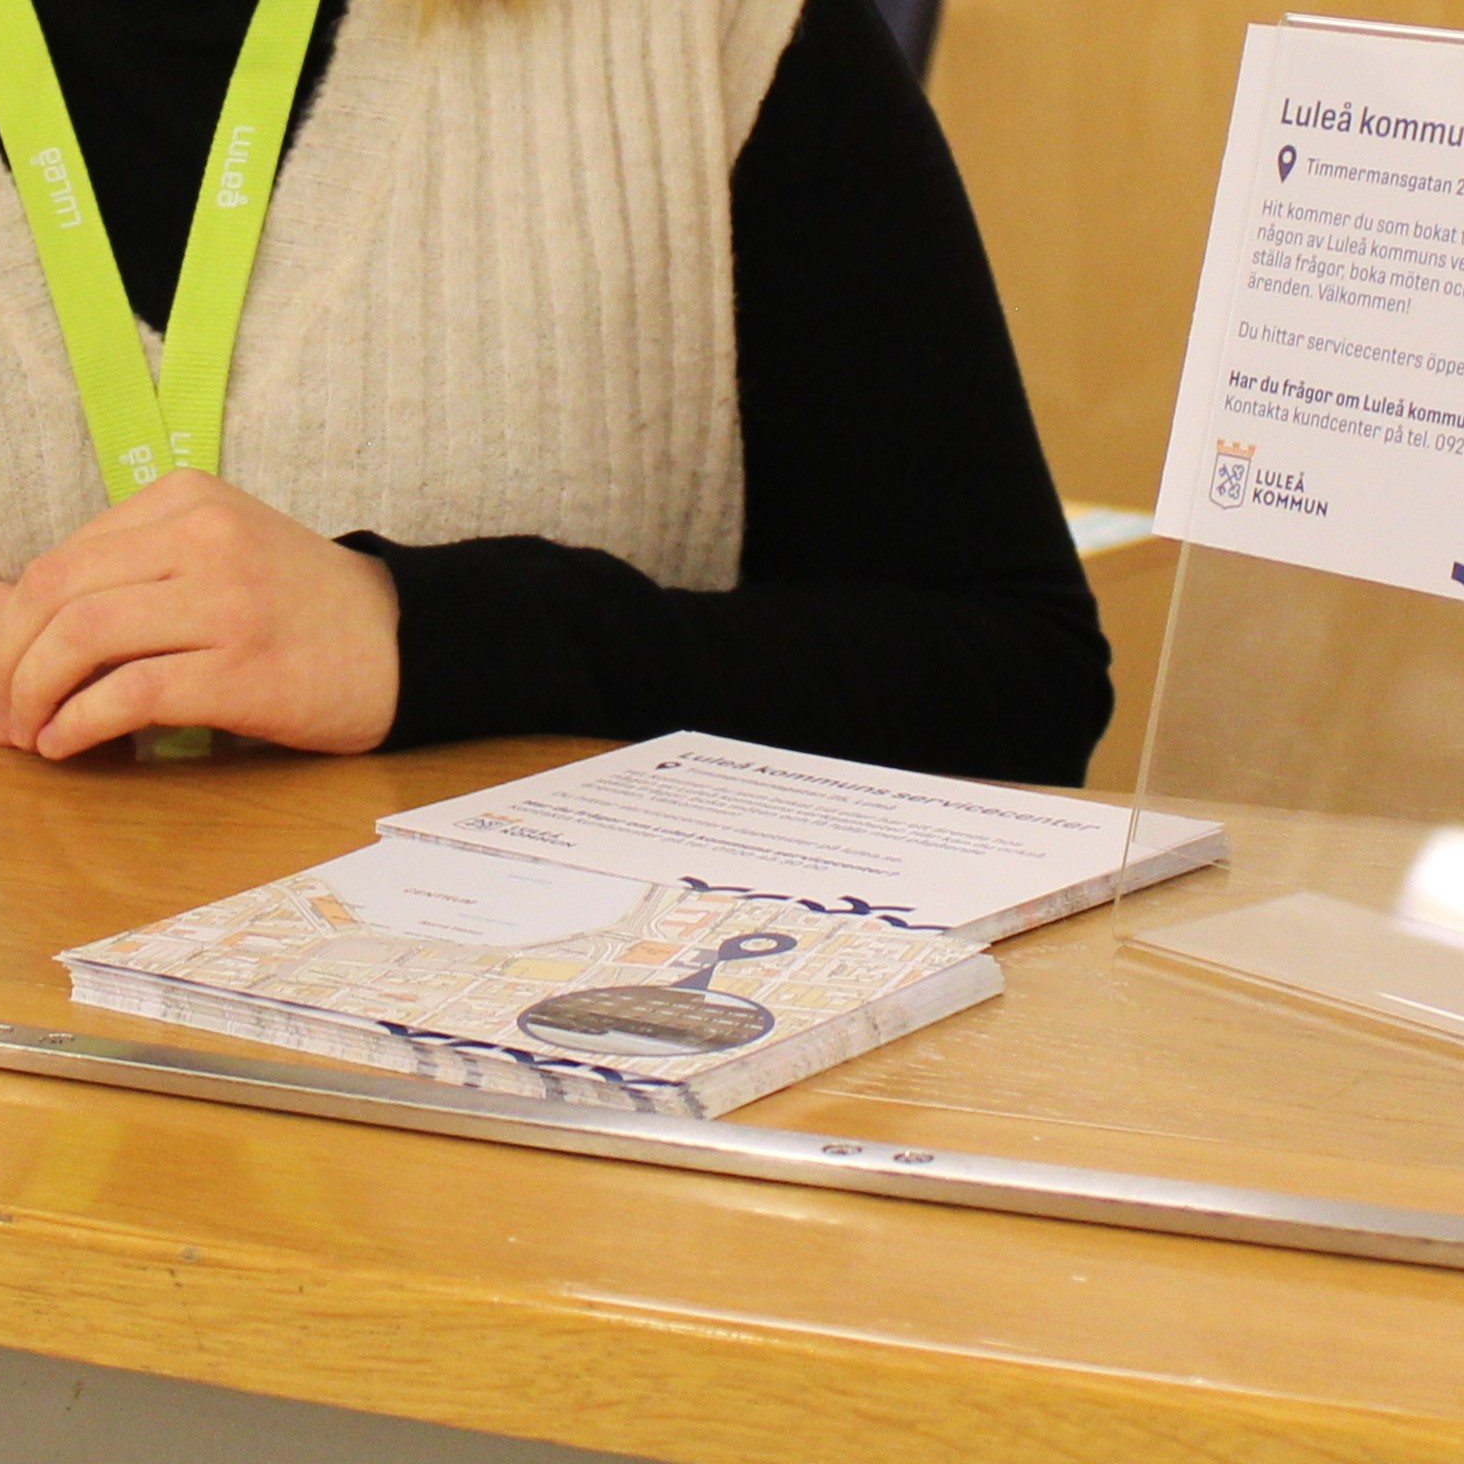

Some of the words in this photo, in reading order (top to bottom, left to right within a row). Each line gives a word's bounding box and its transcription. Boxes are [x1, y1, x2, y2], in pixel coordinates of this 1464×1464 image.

[1281, 98, 1352, 132] Luleå
[1307, 157, 1452, 194] Timmermansgatan
[1262, 199, 1284, 218] Hit
[1286, 202, 1351, 227] kommer
[1354, 213, 1374, 231] du
[1376, 219, 1410, 236] som
[1413, 221, 1457, 244] bokat
[1257, 223, 1303, 246] någon
[1306, 234, 1325, 249] av
[1327, 234, 1367, 256] Luleå
[1370, 239, 1447, 268] kommuns
[1252, 249, 1292, 269] ställa
[1295, 253, 1345, 280] frågor,
[1349, 262, 1386, 284] boka
[1389, 270, 1440, 292] möten
[1247, 275, 1312, 298] ärenden.
[1318, 283, 1411, 313] Välkommen!
[1238, 321, 1259, 340] Du
[1261, 324, 1305, 347] hittar
[1307, 336, 1423, 369] servicecenters
[1229, 370, 1258, 389] Har
[1260, 376, 1279, 394] du
[1282, 379, 1333, 404] frågor
[1336, 393, 1360, 409] om
[1363, 394, 1404, 417] Luleå
[1224, 394, 1289, 422] Kontakta
[1292, 406, 1382, 438] kundcenter
[1383, 424, 1404, 444] på
[1407, 429, 1429, 448] tel.
[1252, 487, 1328, 517] KOMMUN
[1255, 469, 1304, 493] LULEÅ
[754, 764, 889, 796] kommuns
[891, 791, 1102, 833] servicecenter
